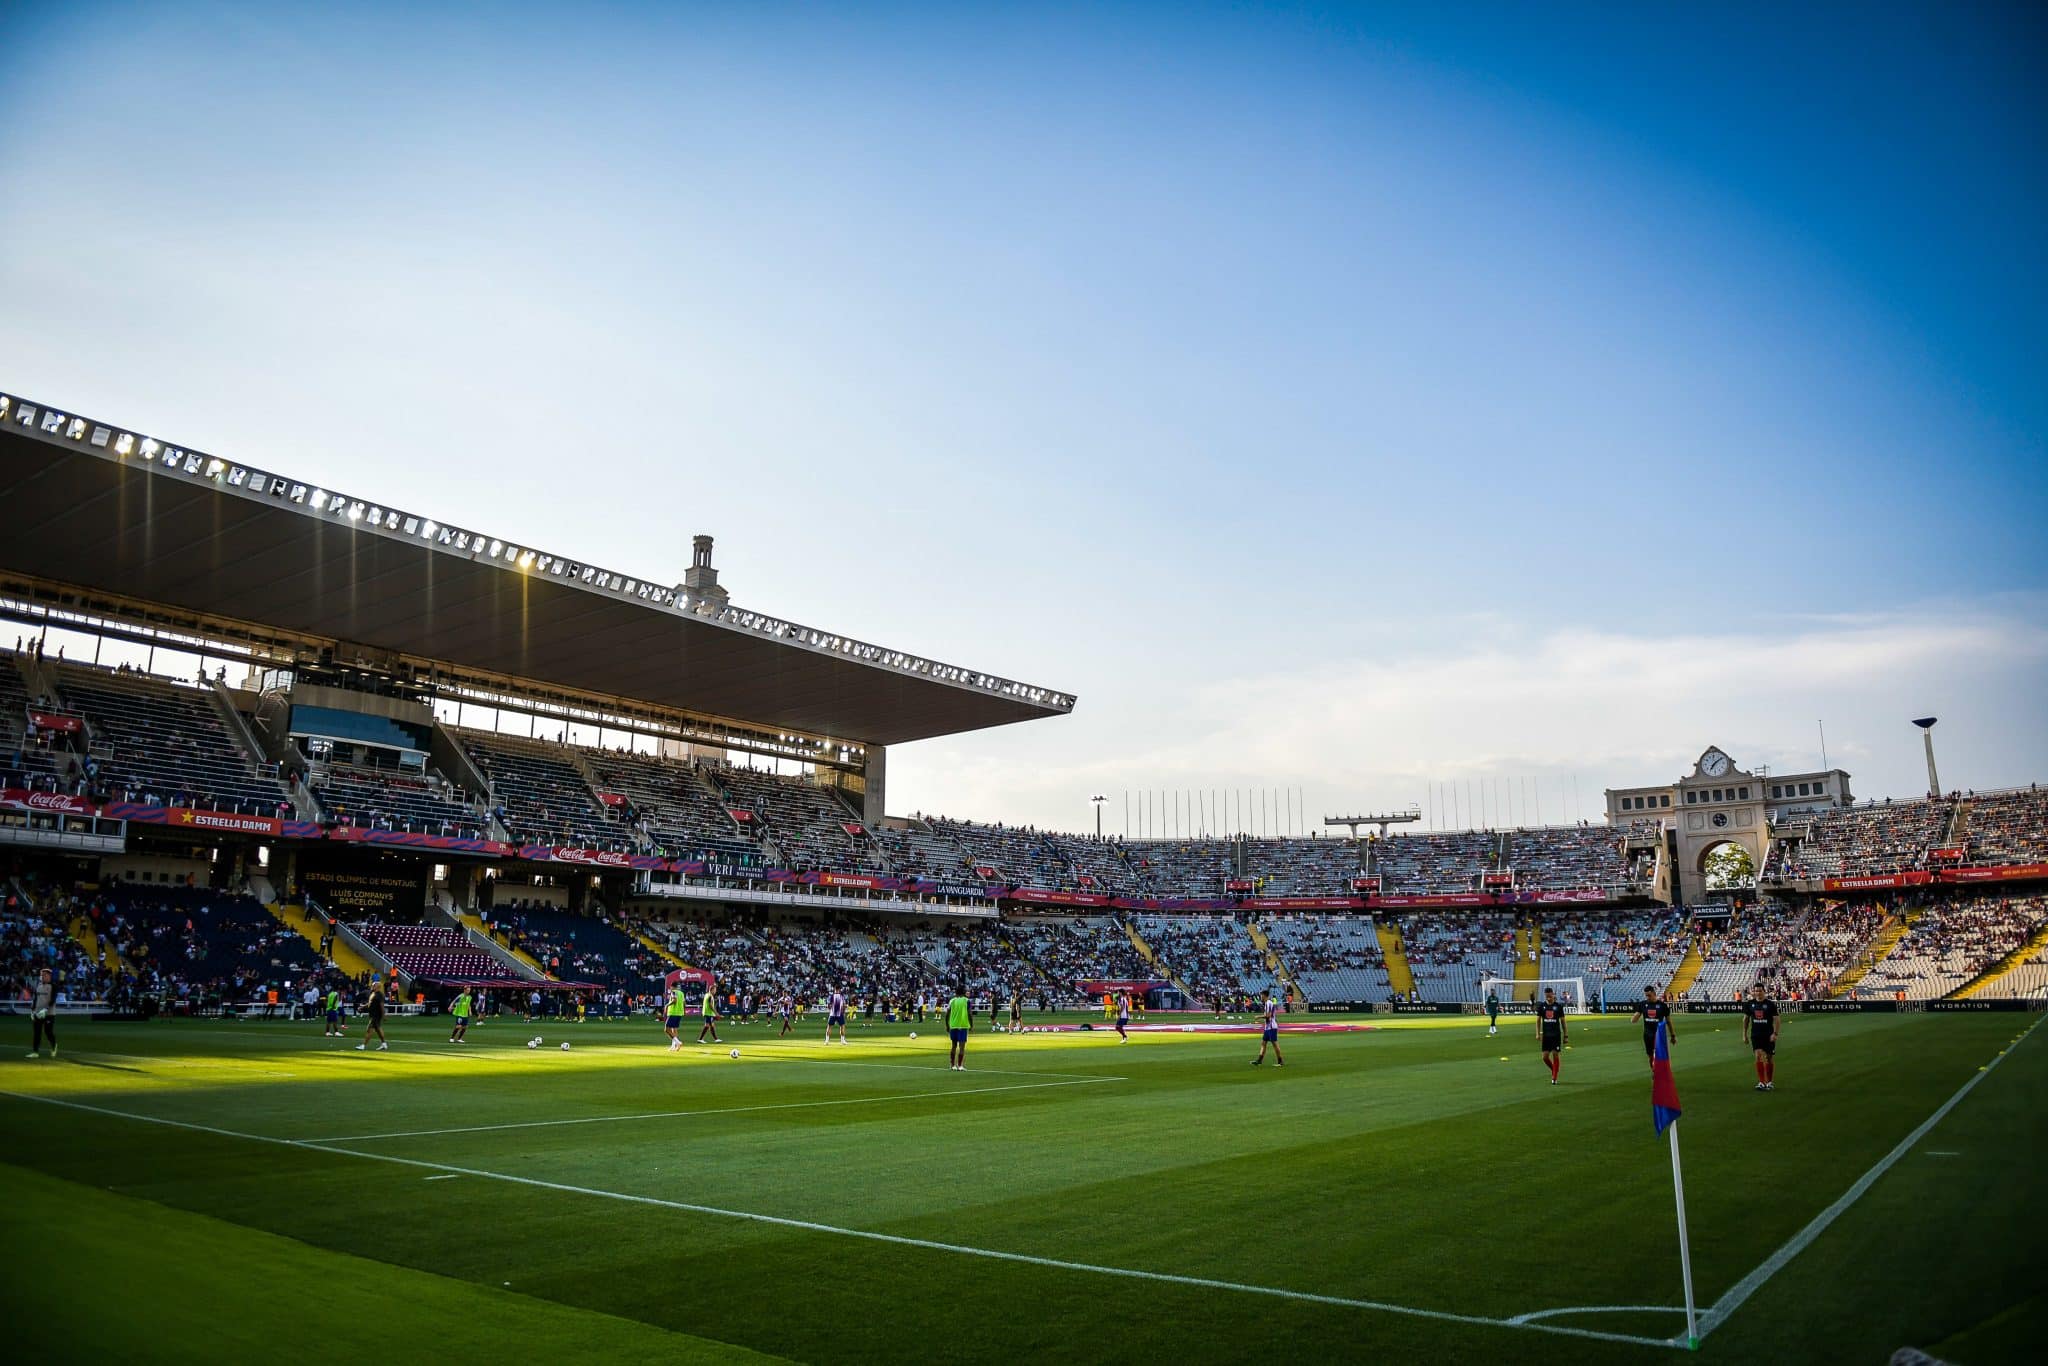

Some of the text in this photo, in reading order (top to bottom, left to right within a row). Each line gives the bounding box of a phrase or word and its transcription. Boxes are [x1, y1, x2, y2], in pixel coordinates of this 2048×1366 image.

[195, 816, 271, 831] ESTRELLA DAMM
[709, 863, 733, 876] VERI
[304, 873, 334, 882] ESTADI
[833, 877, 856, 885] ESTRELLA
[1873, 878, 1895, 886] DAMM
[353, 891, 394, 900] COMPANYS
[946, 886, 985, 896] VANGUARDIA
[339, 898, 384, 907] BARCELONA
